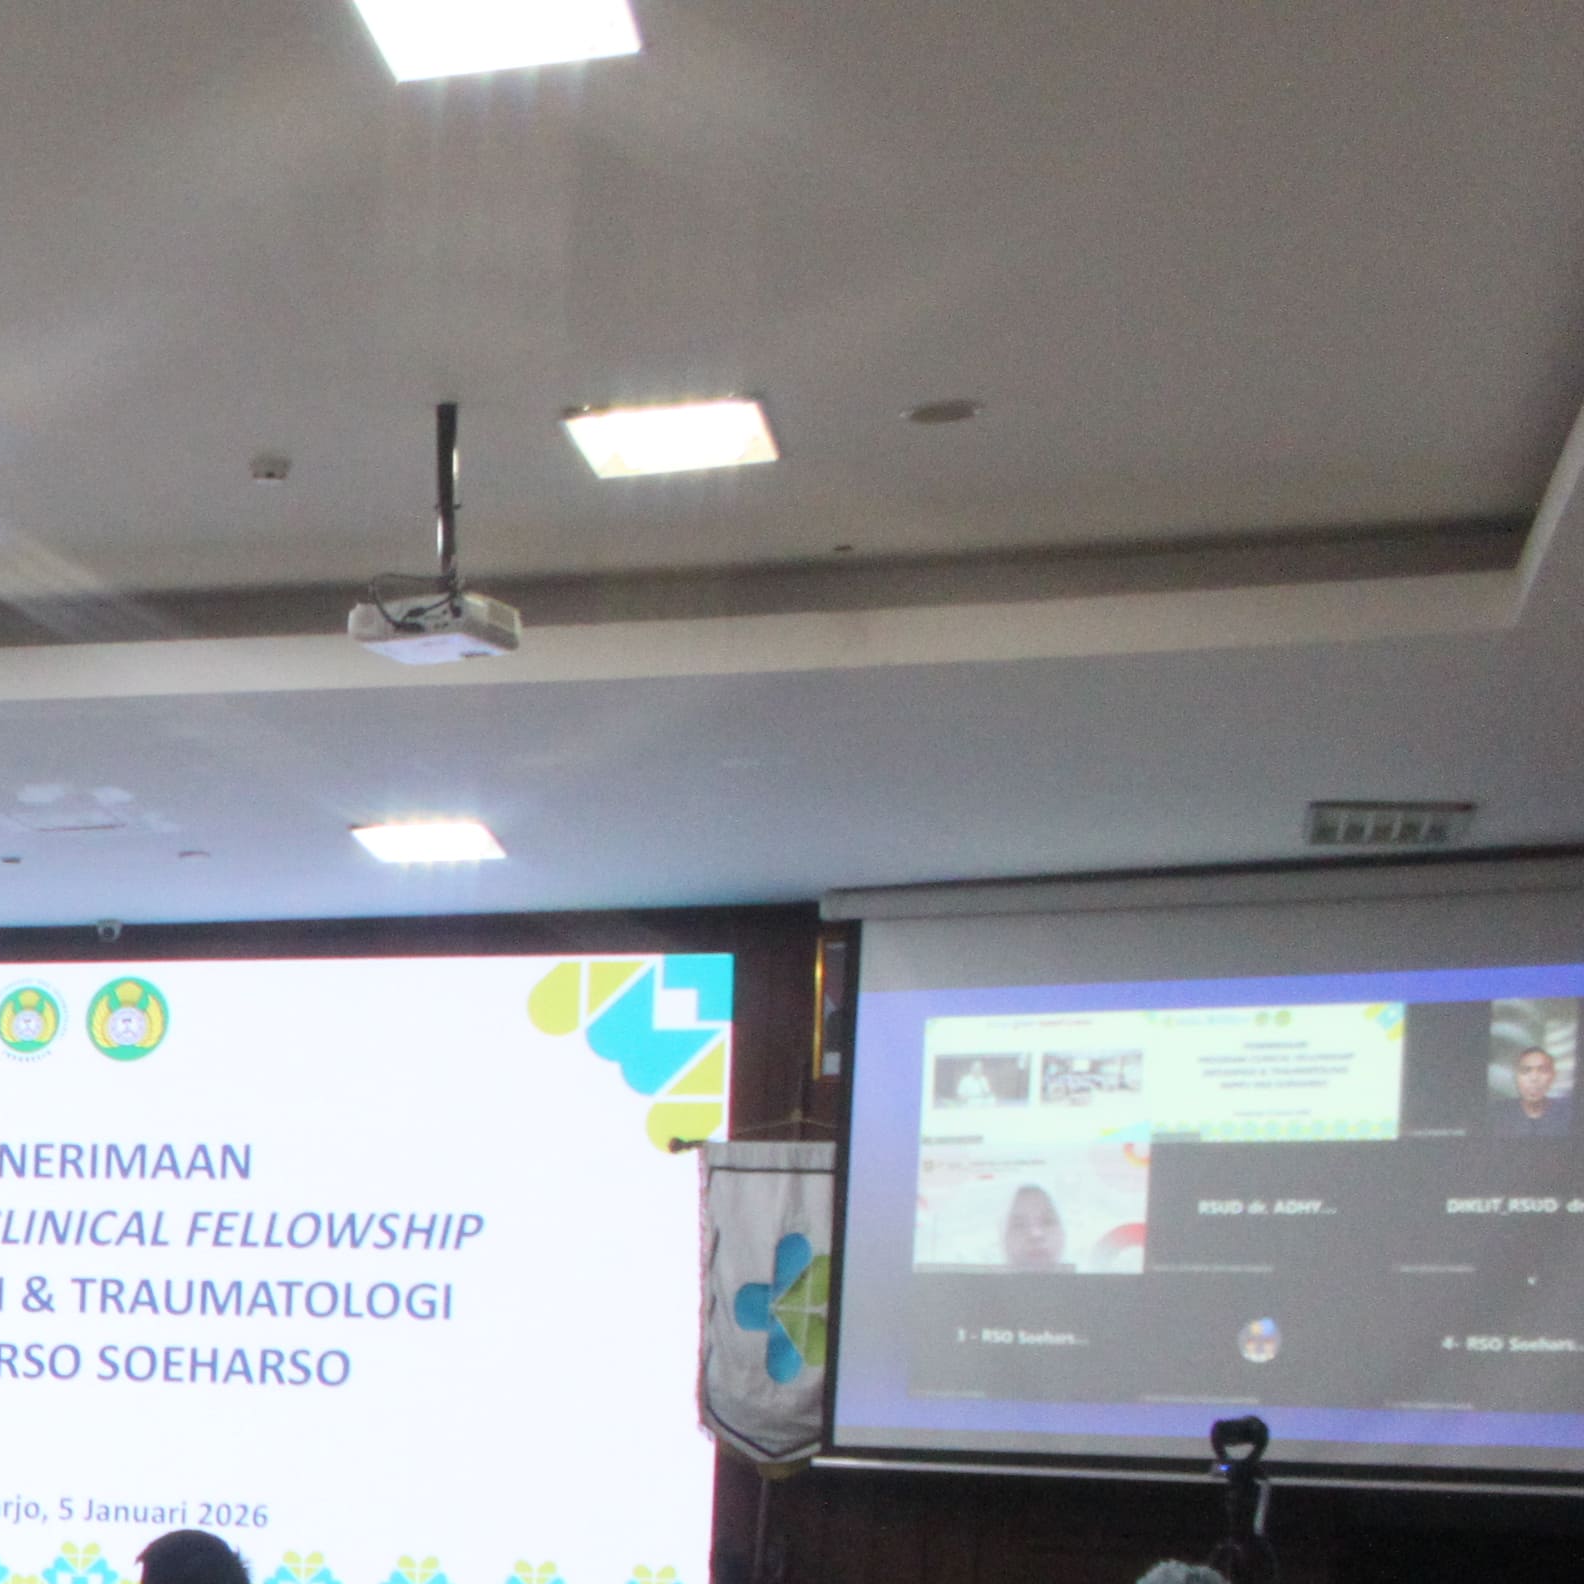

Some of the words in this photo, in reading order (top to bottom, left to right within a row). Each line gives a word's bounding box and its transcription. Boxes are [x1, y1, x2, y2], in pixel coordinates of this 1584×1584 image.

[185, 1210, 485, 1251] FELLOWSHIP
[21, 1275, 56, 1314] &
[70, 1277, 452, 1321] TRAUMATOLOGI
[96, 1344, 351, 1387] SOEHARSO
[59, 1497, 74, 1521] 5
[84, 1497, 188, 1526] Januari
[197, 1502, 269, 1528] 2026
